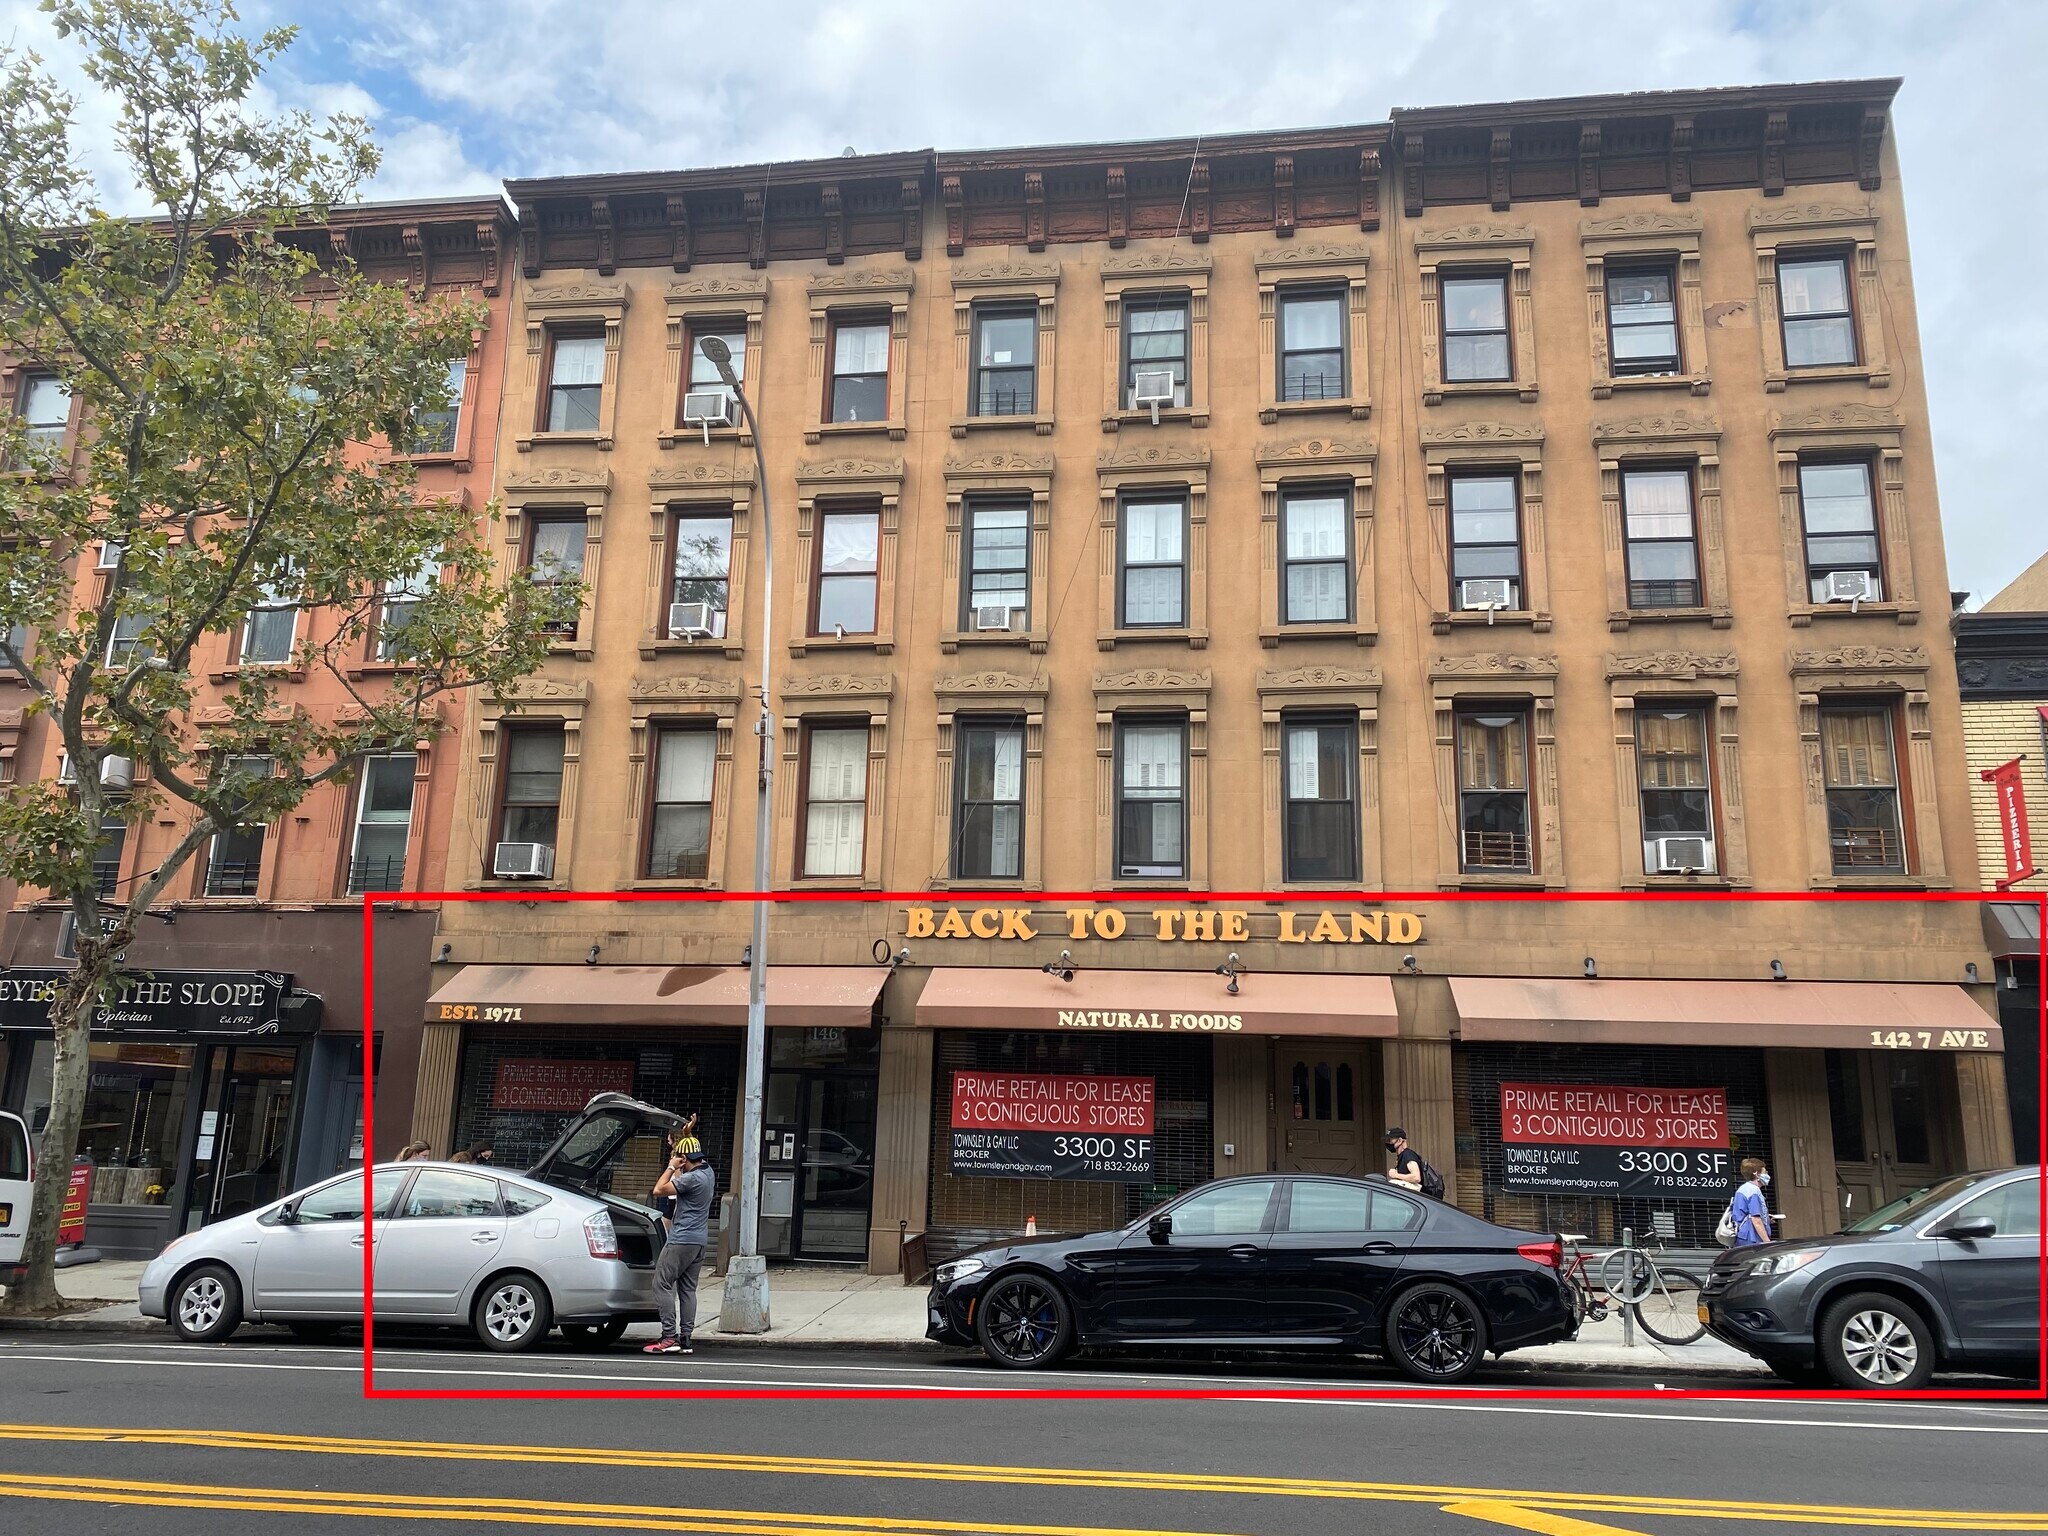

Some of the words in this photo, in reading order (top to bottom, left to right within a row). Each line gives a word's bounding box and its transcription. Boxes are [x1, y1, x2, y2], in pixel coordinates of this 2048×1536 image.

[2005, 786, 2024, 872] PIZZERIA
[905, 906, 1038, 941] BACK
[1066, 908, 1127, 940] TO
[1152, 909, 1249, 942] THE
[1277, 910, 1423, 944] LAND
[180, 983, 265, 1006] SLOPE
[97, 1009, 153, 1024] Opticians
[232, 1015, 254, 1024] 1972
[440, 1005, 479, 1020] EST.
[483, 1007, 522, 1023] 1971
[1057, 1011, 1164, 1029] NATURAL
[1169, 1013, 1243, 1031] FOODS
[812, 1027, 838, 1040] 146
[1870, 1031, 1912, 1048] 142
[1917, 1031, 1932, 1049] 7
[1939, 1030, 1989, 1048] AVE
[502, 1064, 535, 1083] PRIME
[571, 1066, 594, 1085] FOR
[509, 1086, 582, 1106] CONTIGUOUS
[956, 1078, 1005, 1098] PRIME
[1009, 1080, 1060, 1100] RETAIL
[1065, 1081, 1098, 1101] FOR
[1104, 1082, 1151, 1103] LEASE
[1505, 1090, 1559, 1111] PRIME
[1564, 1092, 1621, 1113] RETAIL
[1627, 1093, 1664, 1114] FOR
[1670, 1094, 1723, 1115] LEASE
[961, 1101, 970, 1121] 3
[974, 1101, 1080, 1125] CONTIGUOUS
[1089, 1105, 1145, 1126] STORES
[1512, 1114, 1522, 1135] 3
[1527, 1115, 1646, 1139] CONTIGUOUS
[1655, 1118, 1718, 1140] STORES
[954, 1134, 986, 1148] TOWNSLEY
[986, 1135, 992, 1148] &
[992, 1135, 1006, 1149] GAY
[1006, 1136, 1019, 1150] LLC
[1053, 1136, 1115, 1158] 3300
[1123, 1139, 1151, 1159] SF
[953, 1150, 990, 1159] BROKER
[1507, 1149, 1542, 1163] TOWNSLEY
[1543, 1150, 1549, 1163] &
[1550, 1150, 1566, 1164] GAY
[1566, 1151, 1580, 1165] LLC
[1618, 1151, 1688, 1173] 3300
[1697, 1153, 1728, 1174] SF
[953, 1161, 1053, 1172] www.townsleyandgay.com
[1083, 1160, 1101, 1171] 718
[1104, 1161, 1150, 1172] 832-2669
[1507, 1165, 1548, 1174] BROKER
[1508, 1177, 1619, 1189] www.townsleyandgay.com
[1653, 1176, 1674, 1186] 718
[1676, 1176, 1728, 1188] 832-2669
